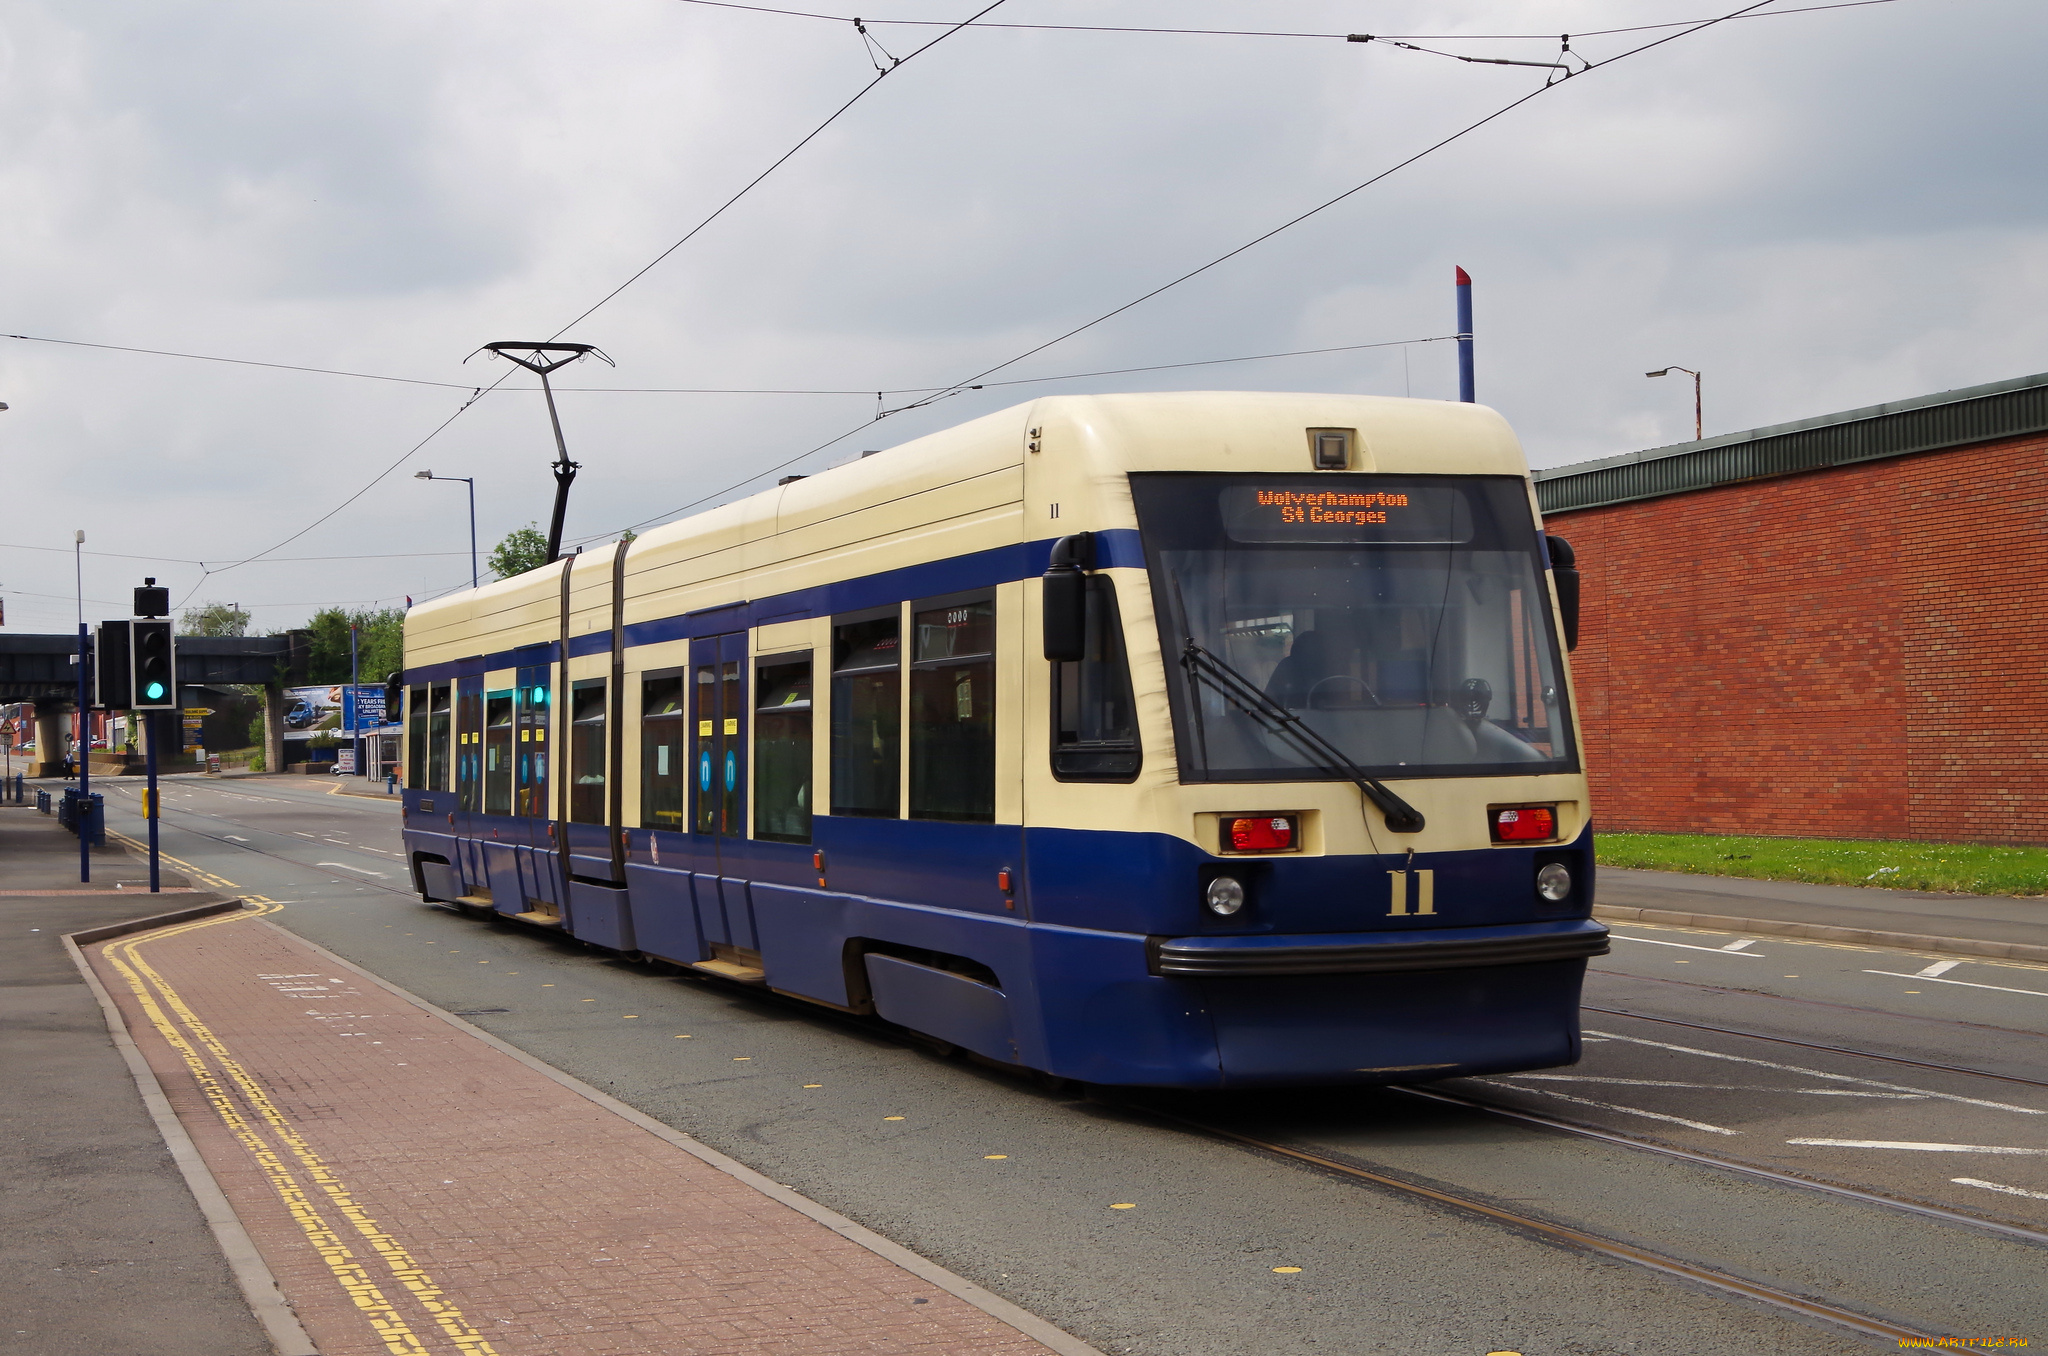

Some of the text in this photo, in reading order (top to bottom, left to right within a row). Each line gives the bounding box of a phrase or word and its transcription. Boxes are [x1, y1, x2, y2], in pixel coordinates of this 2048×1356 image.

[1258, 491, 1408, 507] Wolverhampton
[1282, 506, 1387, 525] St Georges
[1386, 869, 1438, 916] 11
